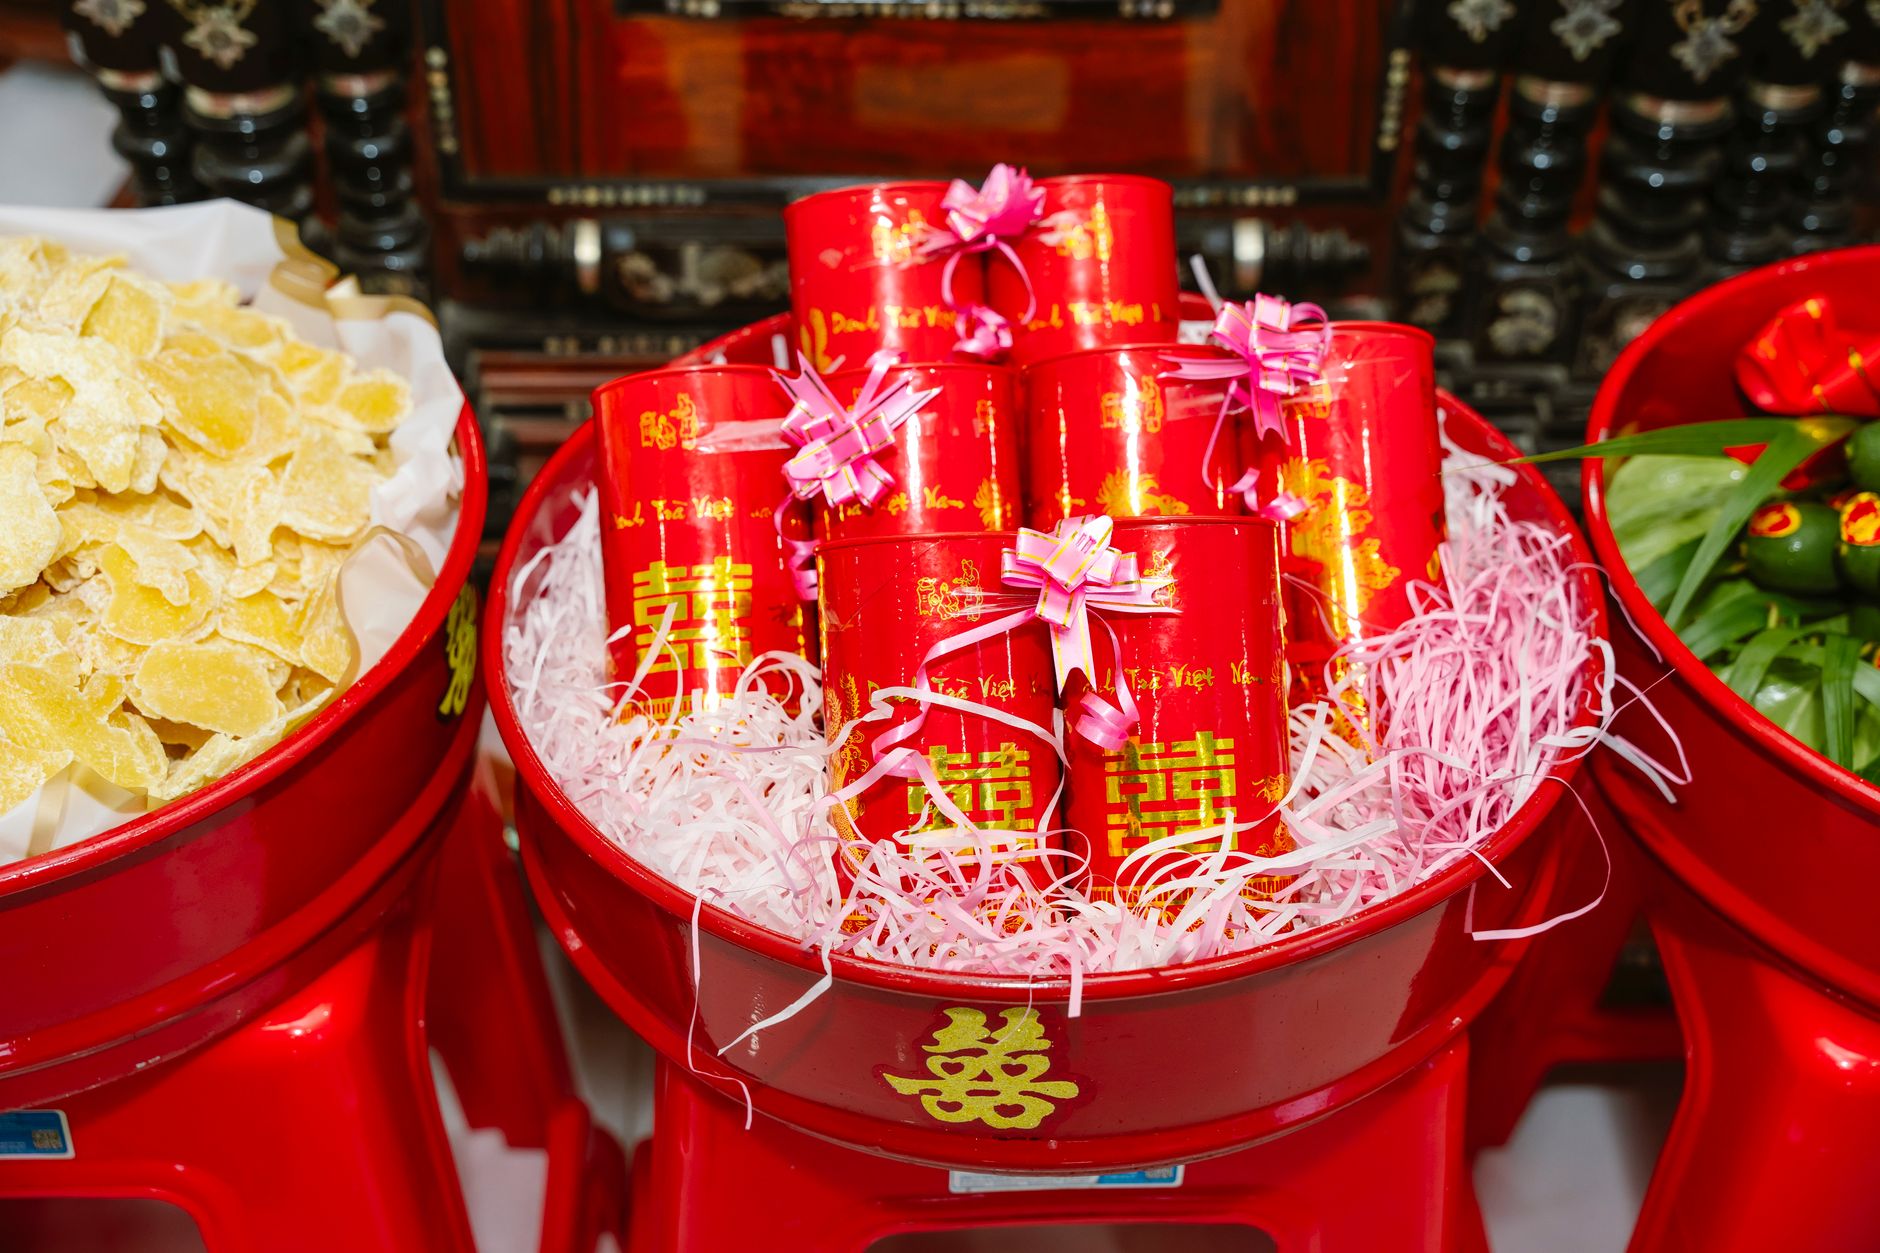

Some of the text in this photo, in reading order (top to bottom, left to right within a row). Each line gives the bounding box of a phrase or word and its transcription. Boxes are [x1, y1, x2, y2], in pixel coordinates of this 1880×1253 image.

[651, 499, 688, 521] Trà
[692, 495, 734, 522] Việt
[930, 676, 972, 700] Trà
[978, 673, 1016, 702] Việt
[1124, 667, 1164, 691] Trà
[1170, 663, 1215, 692] Việt
